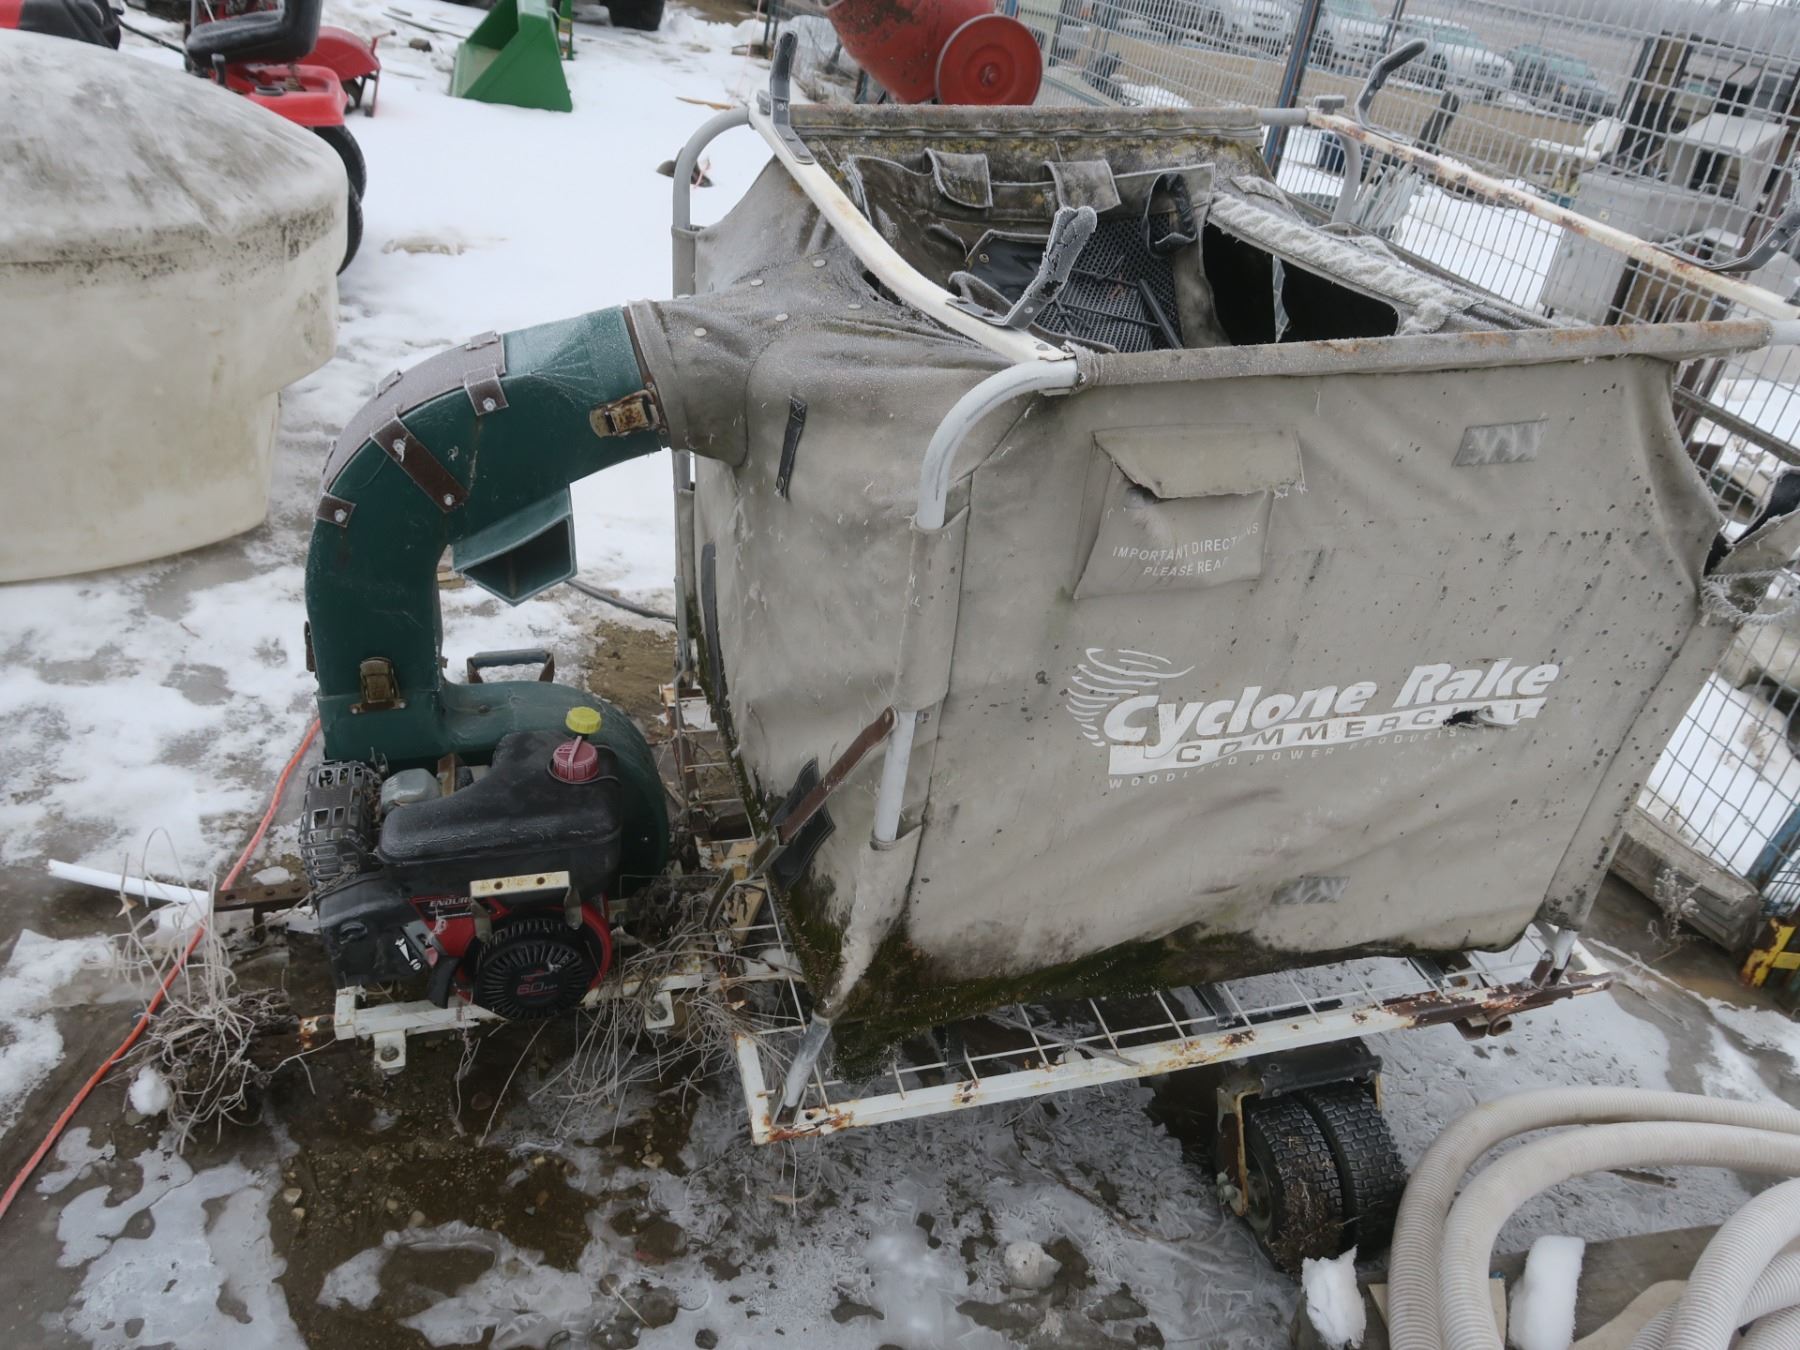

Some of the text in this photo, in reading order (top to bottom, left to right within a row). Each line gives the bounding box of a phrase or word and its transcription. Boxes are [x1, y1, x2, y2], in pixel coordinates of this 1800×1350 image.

[1112, 522, 1259, 561] IMPORTANT DIRECTNS
[1143, 563, 1193, 576] PLEASE
[1104, 657, 1560, 759] Cyclone Rake
[1176, 703, 1527, 763] COMMERCAL
[1256, 747, 1335, 764] POWER
